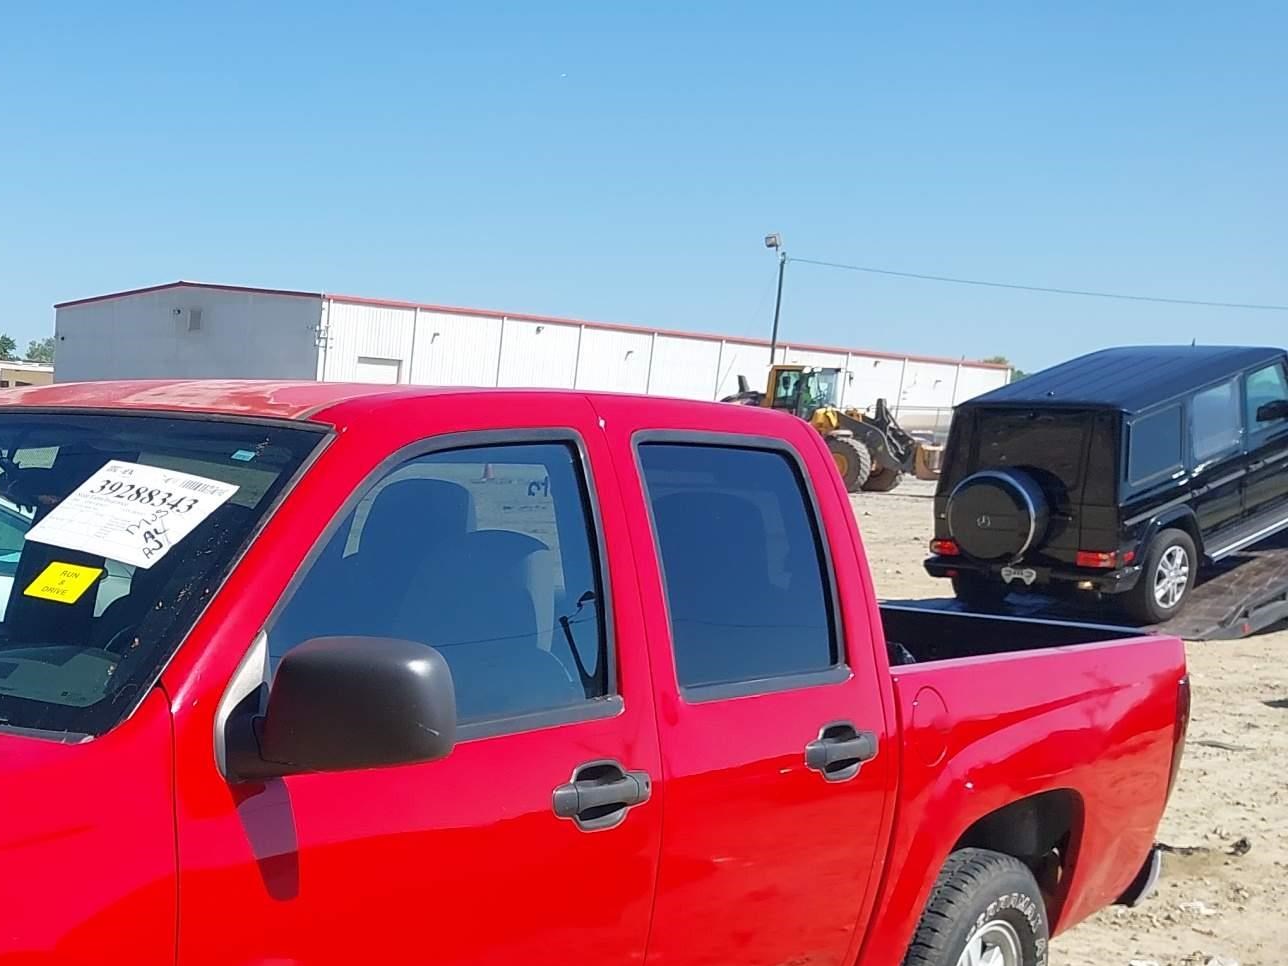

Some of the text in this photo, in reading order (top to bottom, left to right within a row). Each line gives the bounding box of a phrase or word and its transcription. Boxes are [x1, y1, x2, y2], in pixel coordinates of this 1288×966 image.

[90, 479, 200, 514] 39288343
[61, 570, 80, 579] RUN
[41, 585, 68, 596] DRIVE
